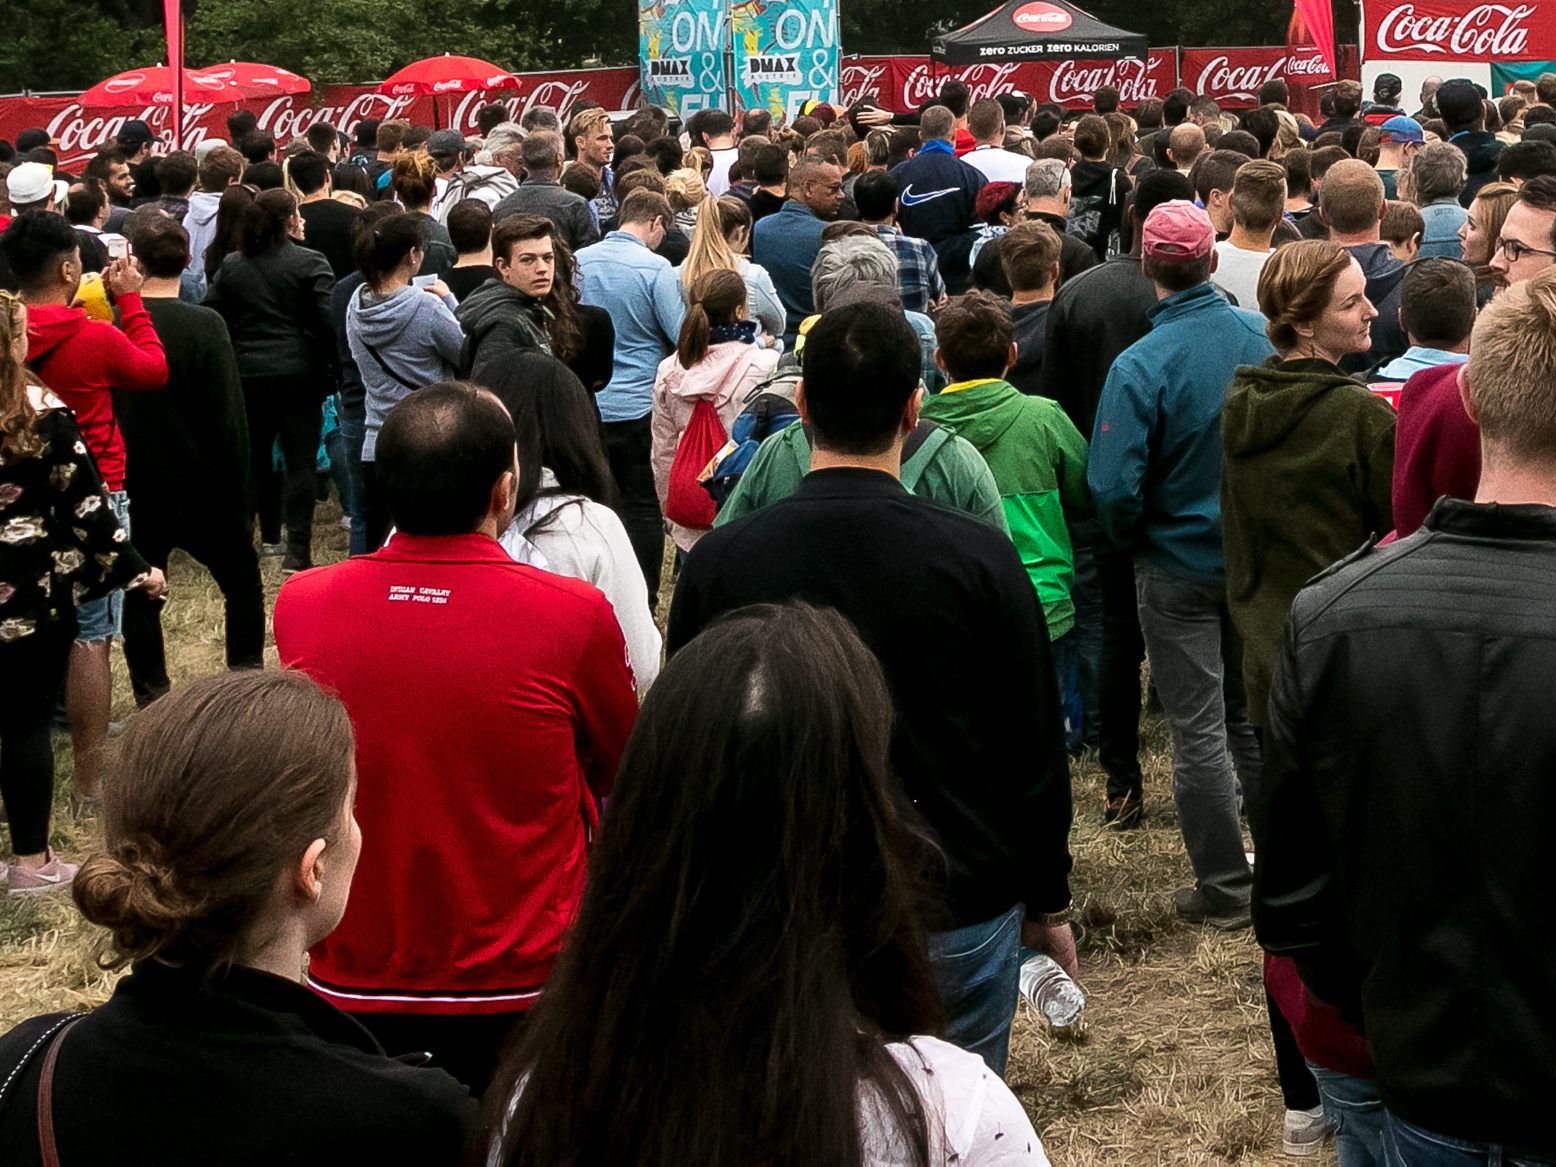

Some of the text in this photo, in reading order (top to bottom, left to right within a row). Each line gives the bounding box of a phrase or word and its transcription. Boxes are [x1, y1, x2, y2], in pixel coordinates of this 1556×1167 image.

[1377, 3, 1539, 55] Coca-Cola
[980, 43, 1119, 56] zero ZUCKER zero KALORIEN
[651, 60, 689, 76] DMAX
[750, 57, 796, 73] DMAX
